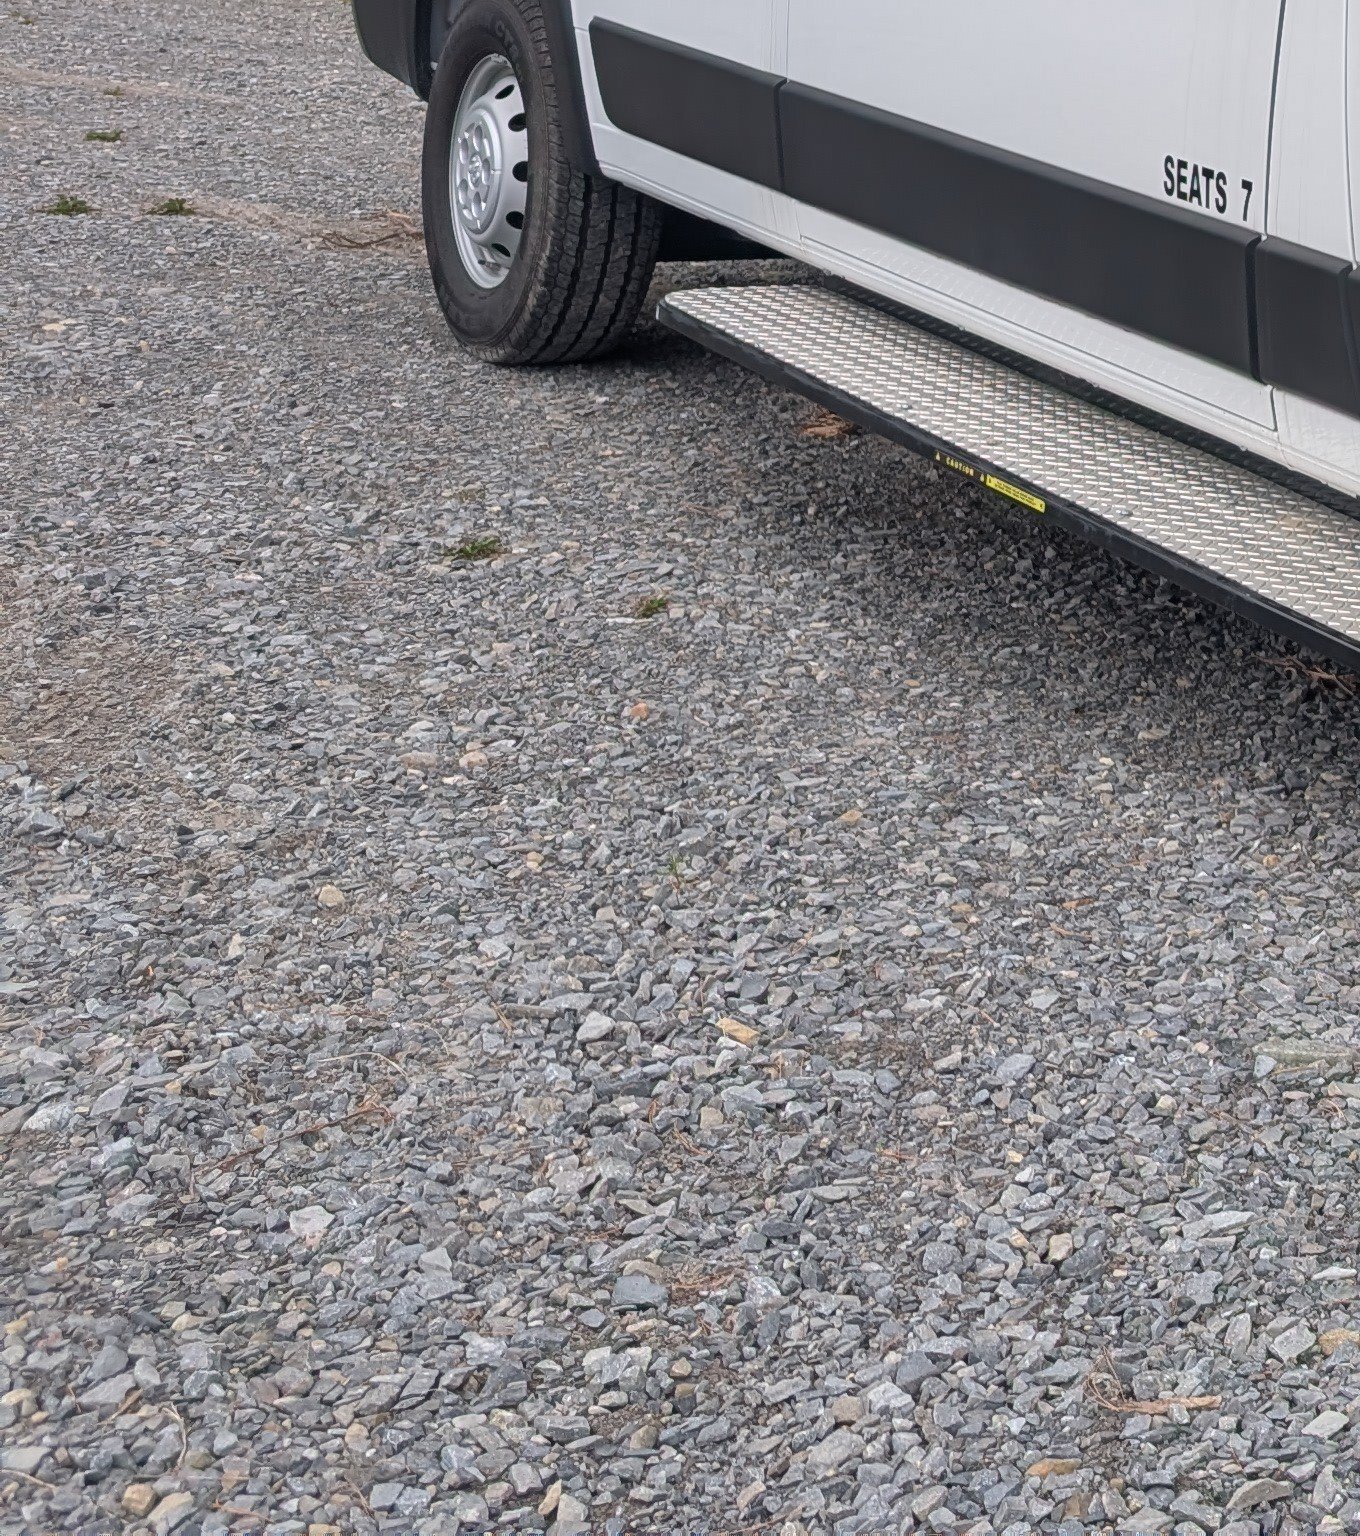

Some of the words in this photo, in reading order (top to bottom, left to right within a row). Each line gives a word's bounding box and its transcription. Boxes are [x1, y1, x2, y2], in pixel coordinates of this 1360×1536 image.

[1163, 155, 1227, 214] SEATS
[1241, 178, 1253, 222] 7
[946, 455, 975, 477] CAUTION
